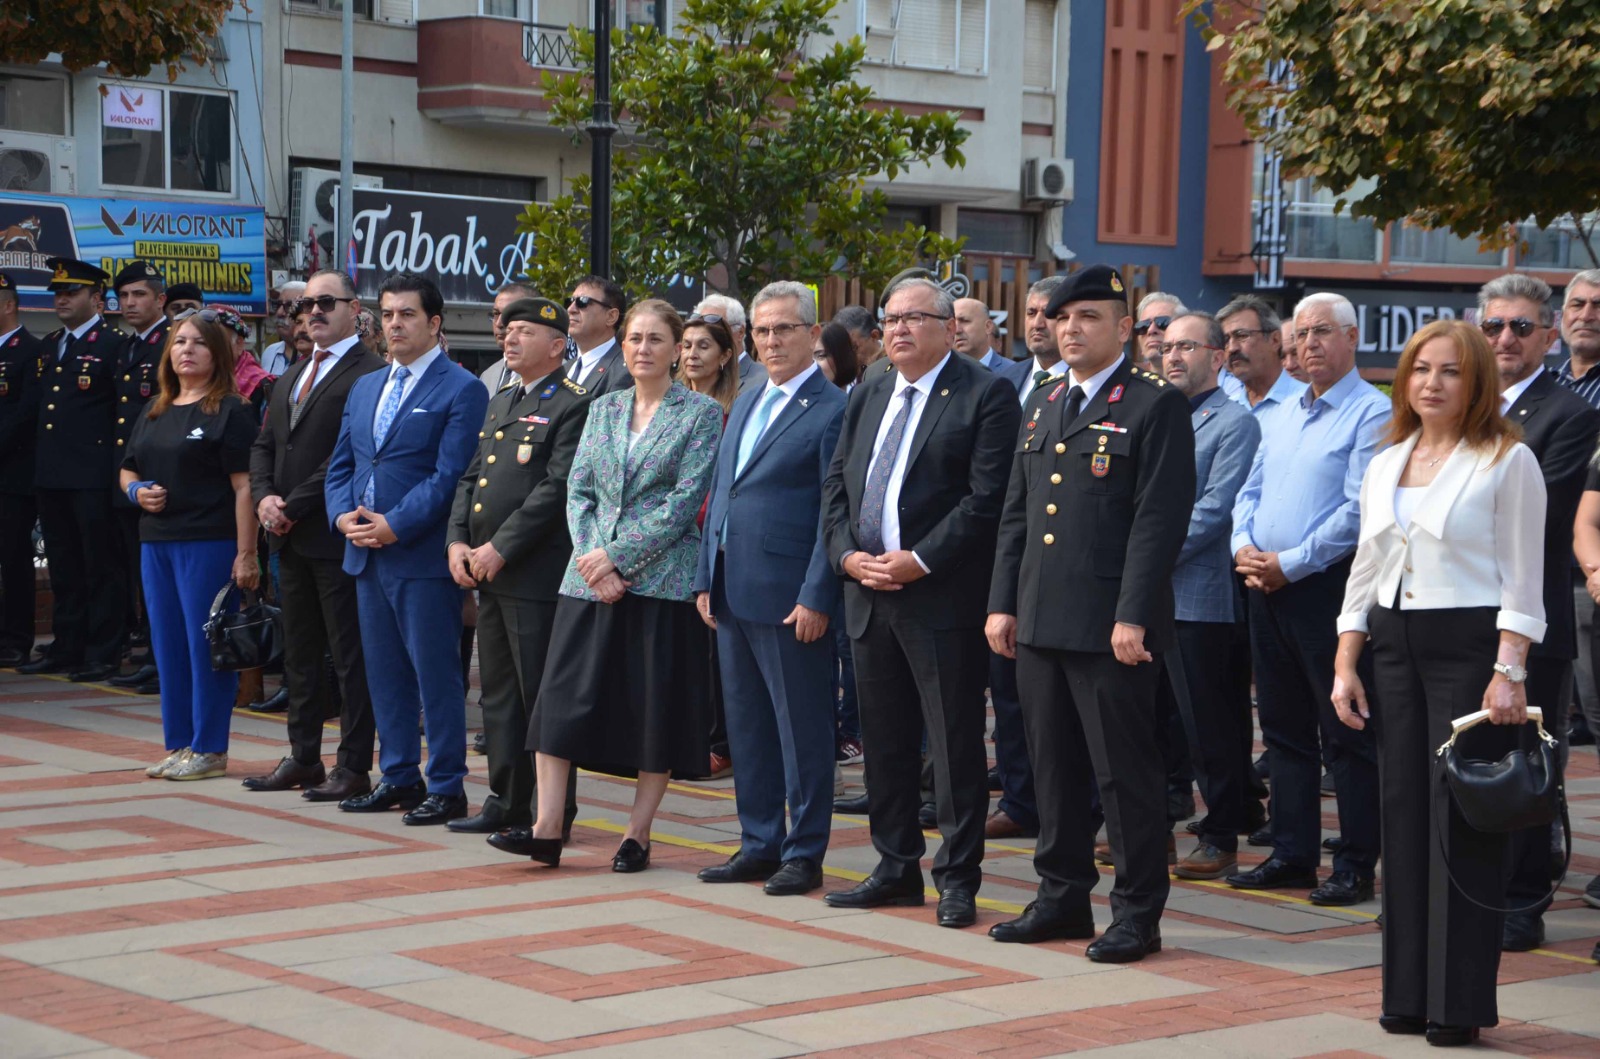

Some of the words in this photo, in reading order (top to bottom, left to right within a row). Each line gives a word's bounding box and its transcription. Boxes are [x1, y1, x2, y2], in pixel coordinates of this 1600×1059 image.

[110, 114, 154, 126] VALORANT
[142, 212, 247, 238] VALORANT
[139, 242, 215, 257] PLAYERUNKNOWN'S
[352, 203, 488, 276] Tabak
